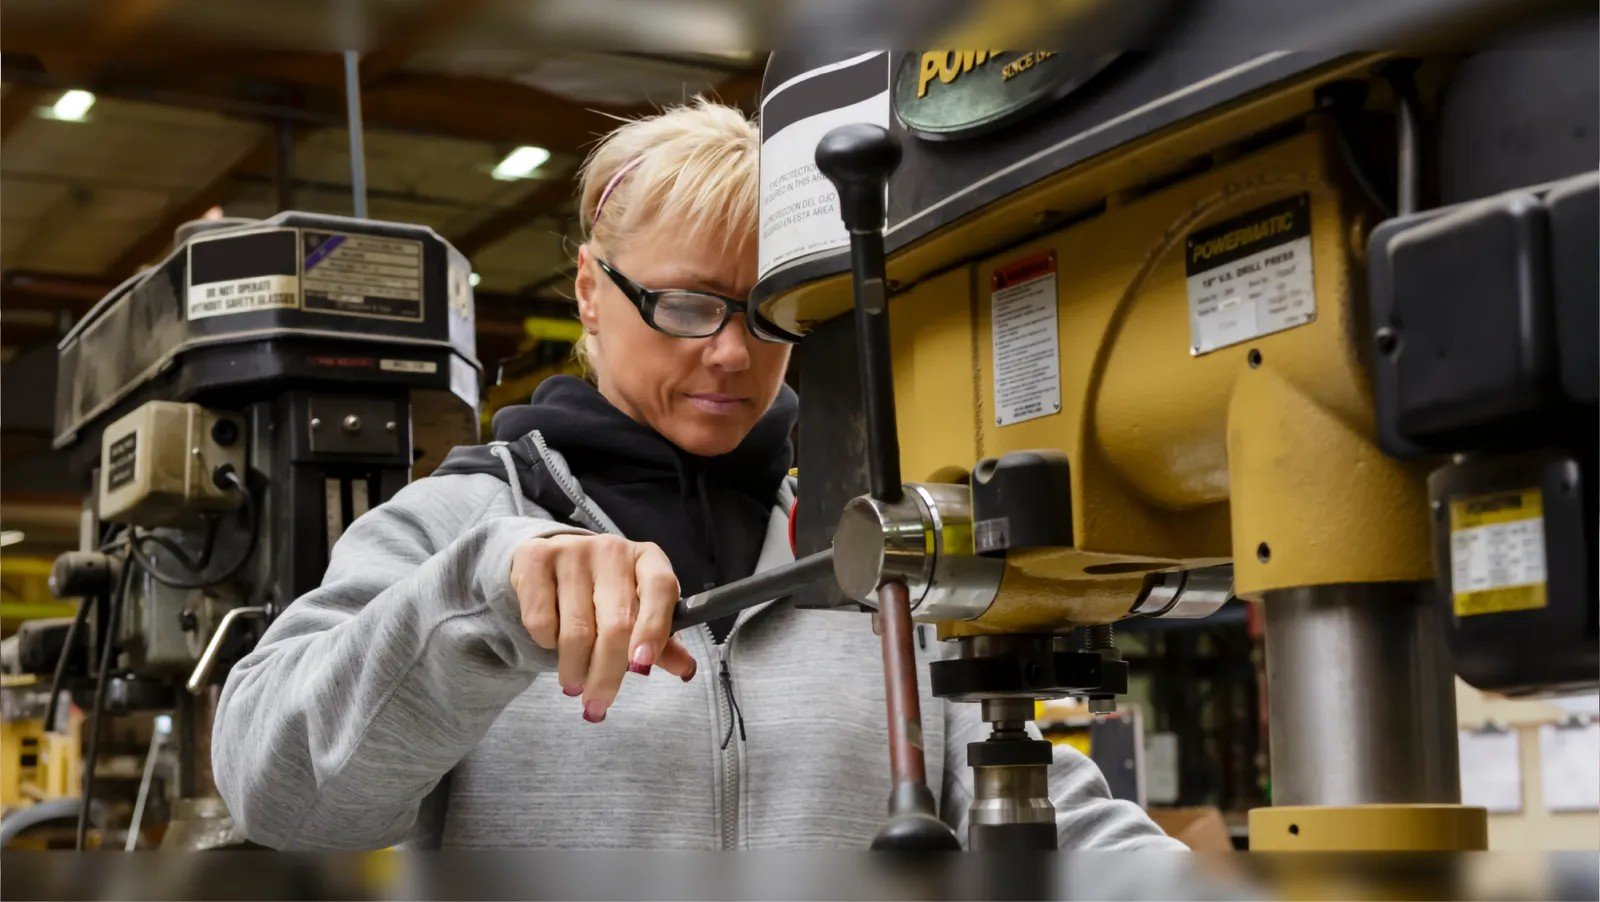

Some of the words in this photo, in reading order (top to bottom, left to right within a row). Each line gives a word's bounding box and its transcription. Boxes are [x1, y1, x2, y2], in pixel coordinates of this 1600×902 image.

[795, 175, 810, 188] THIS
[802, 198, 815, 209] DEL
[818, 192, 836, 204] OJO
[793, 210, 811, 223] ESTA
[812, 204, 834, 216] AREA
[1193, 211, 1295, 263] POWERMATIC
[1236, 262, 1262, 278] DRILL
[1264, 250, 1295, 267] PRESS
[206, 287, 216, 298] DO
[219, 285, 234, 296] NOT
[238, 280, 271, 294] OPERATE
[191, 300, 222, 314] WITHOUT
[226, 296, 254, 309] SAFETY
